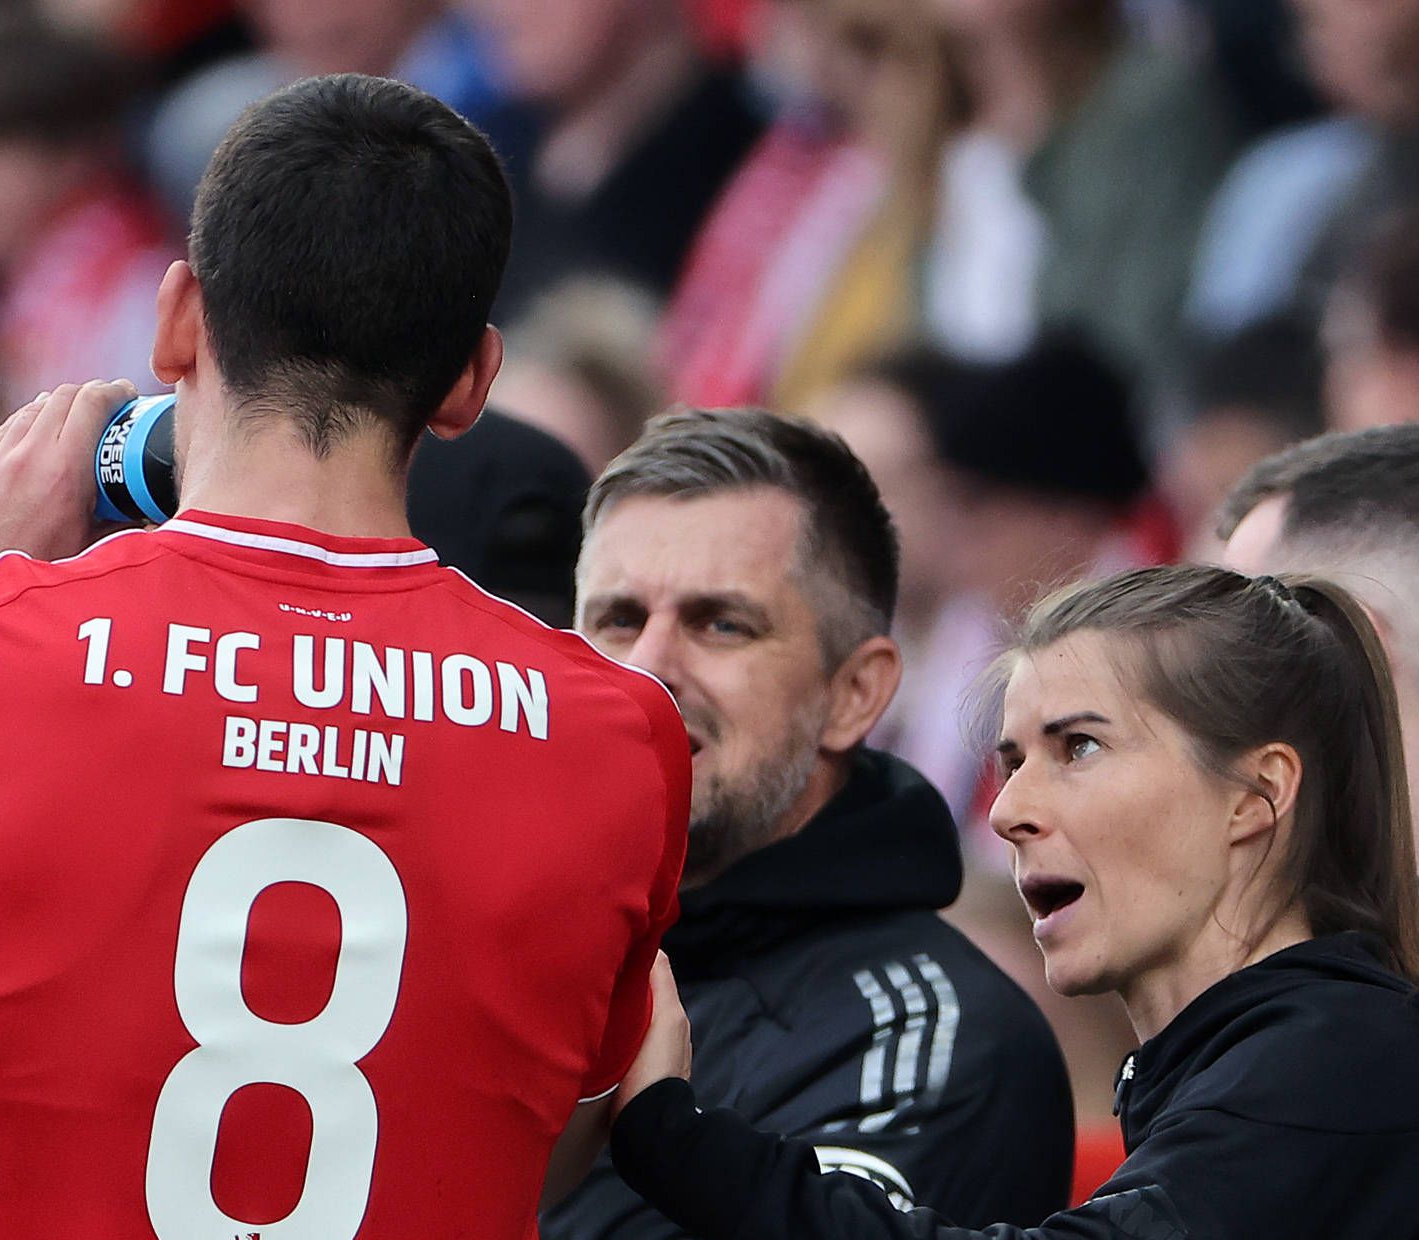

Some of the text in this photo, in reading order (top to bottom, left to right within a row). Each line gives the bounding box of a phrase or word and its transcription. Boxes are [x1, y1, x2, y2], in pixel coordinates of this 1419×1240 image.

[100, 425, 121, 484] ADE
[77, 616, 549, 741] 1. FC UNION
[222, 716, 405, 786] BERLIN
